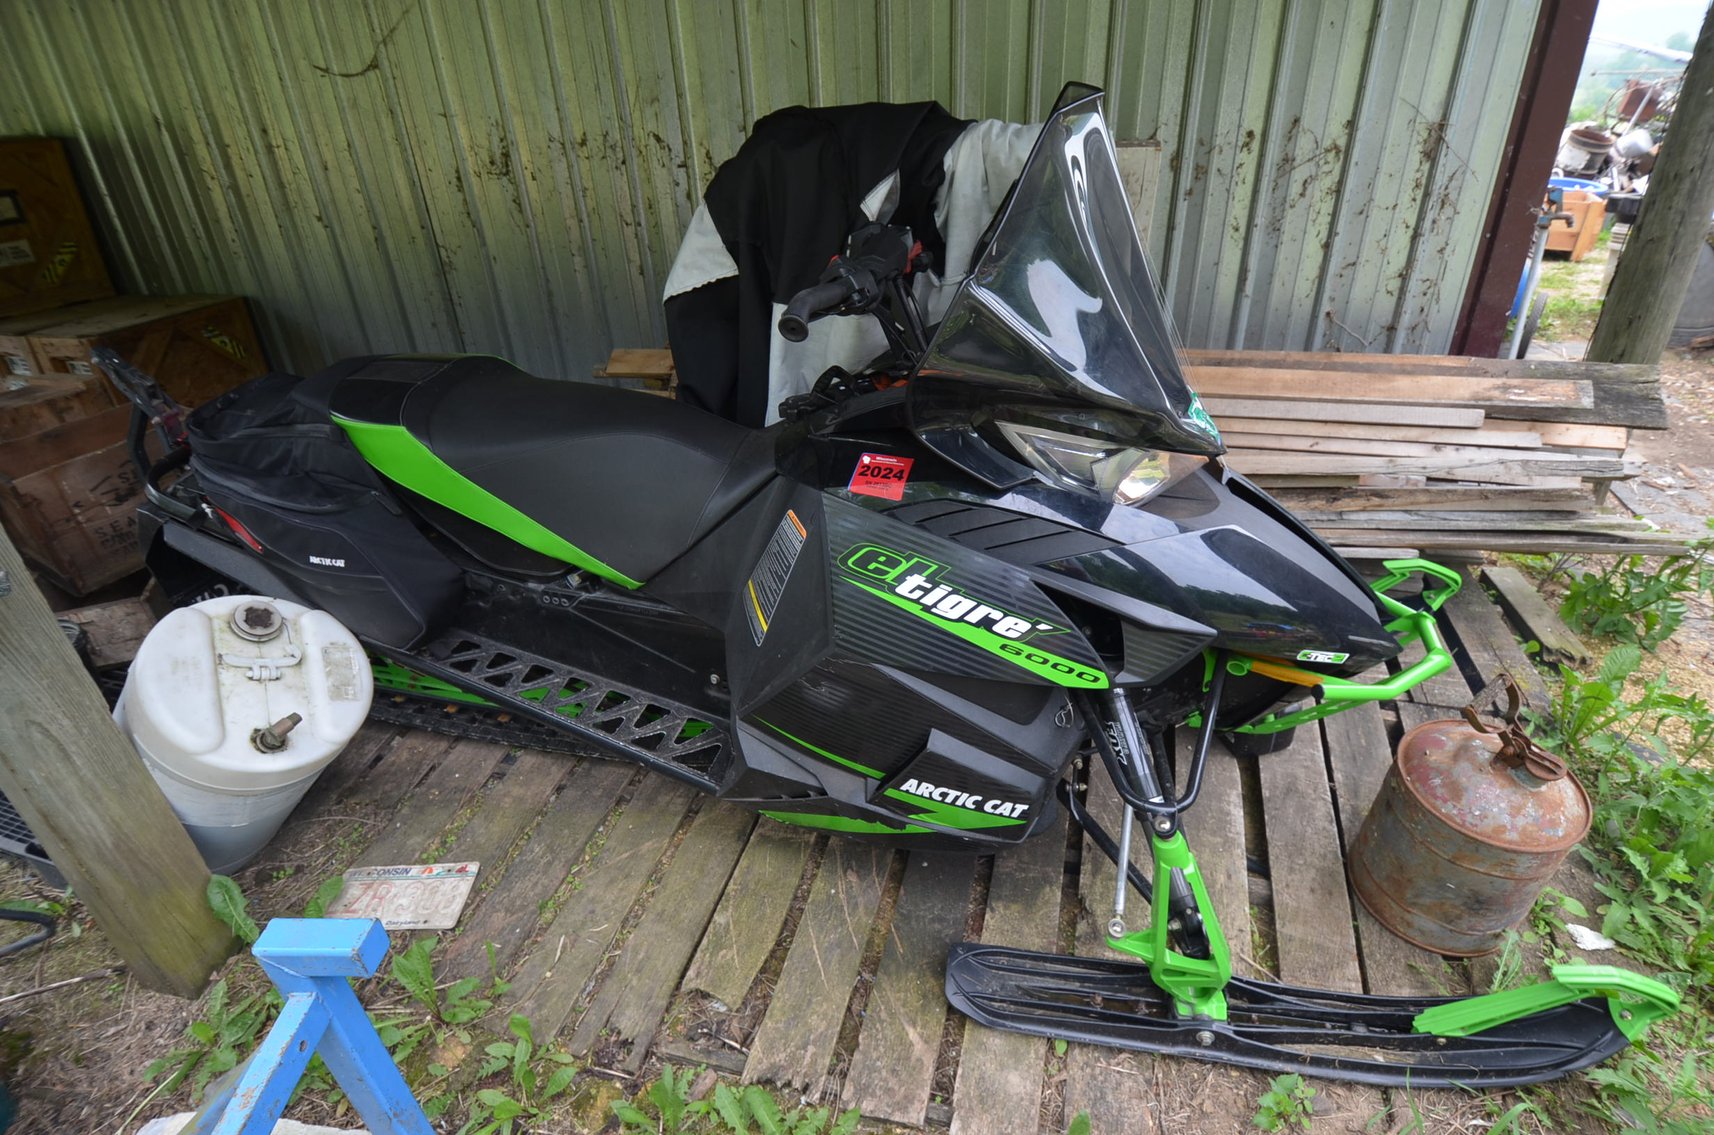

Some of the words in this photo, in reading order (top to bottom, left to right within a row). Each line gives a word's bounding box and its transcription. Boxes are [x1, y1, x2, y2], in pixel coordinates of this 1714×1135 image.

[858, 465, 905, 481] 2024
[999, 643, 1101, 684] 6000
[899, 778, 983, 809] ARCTIC
[983, 799, 1029, 818] CAT
